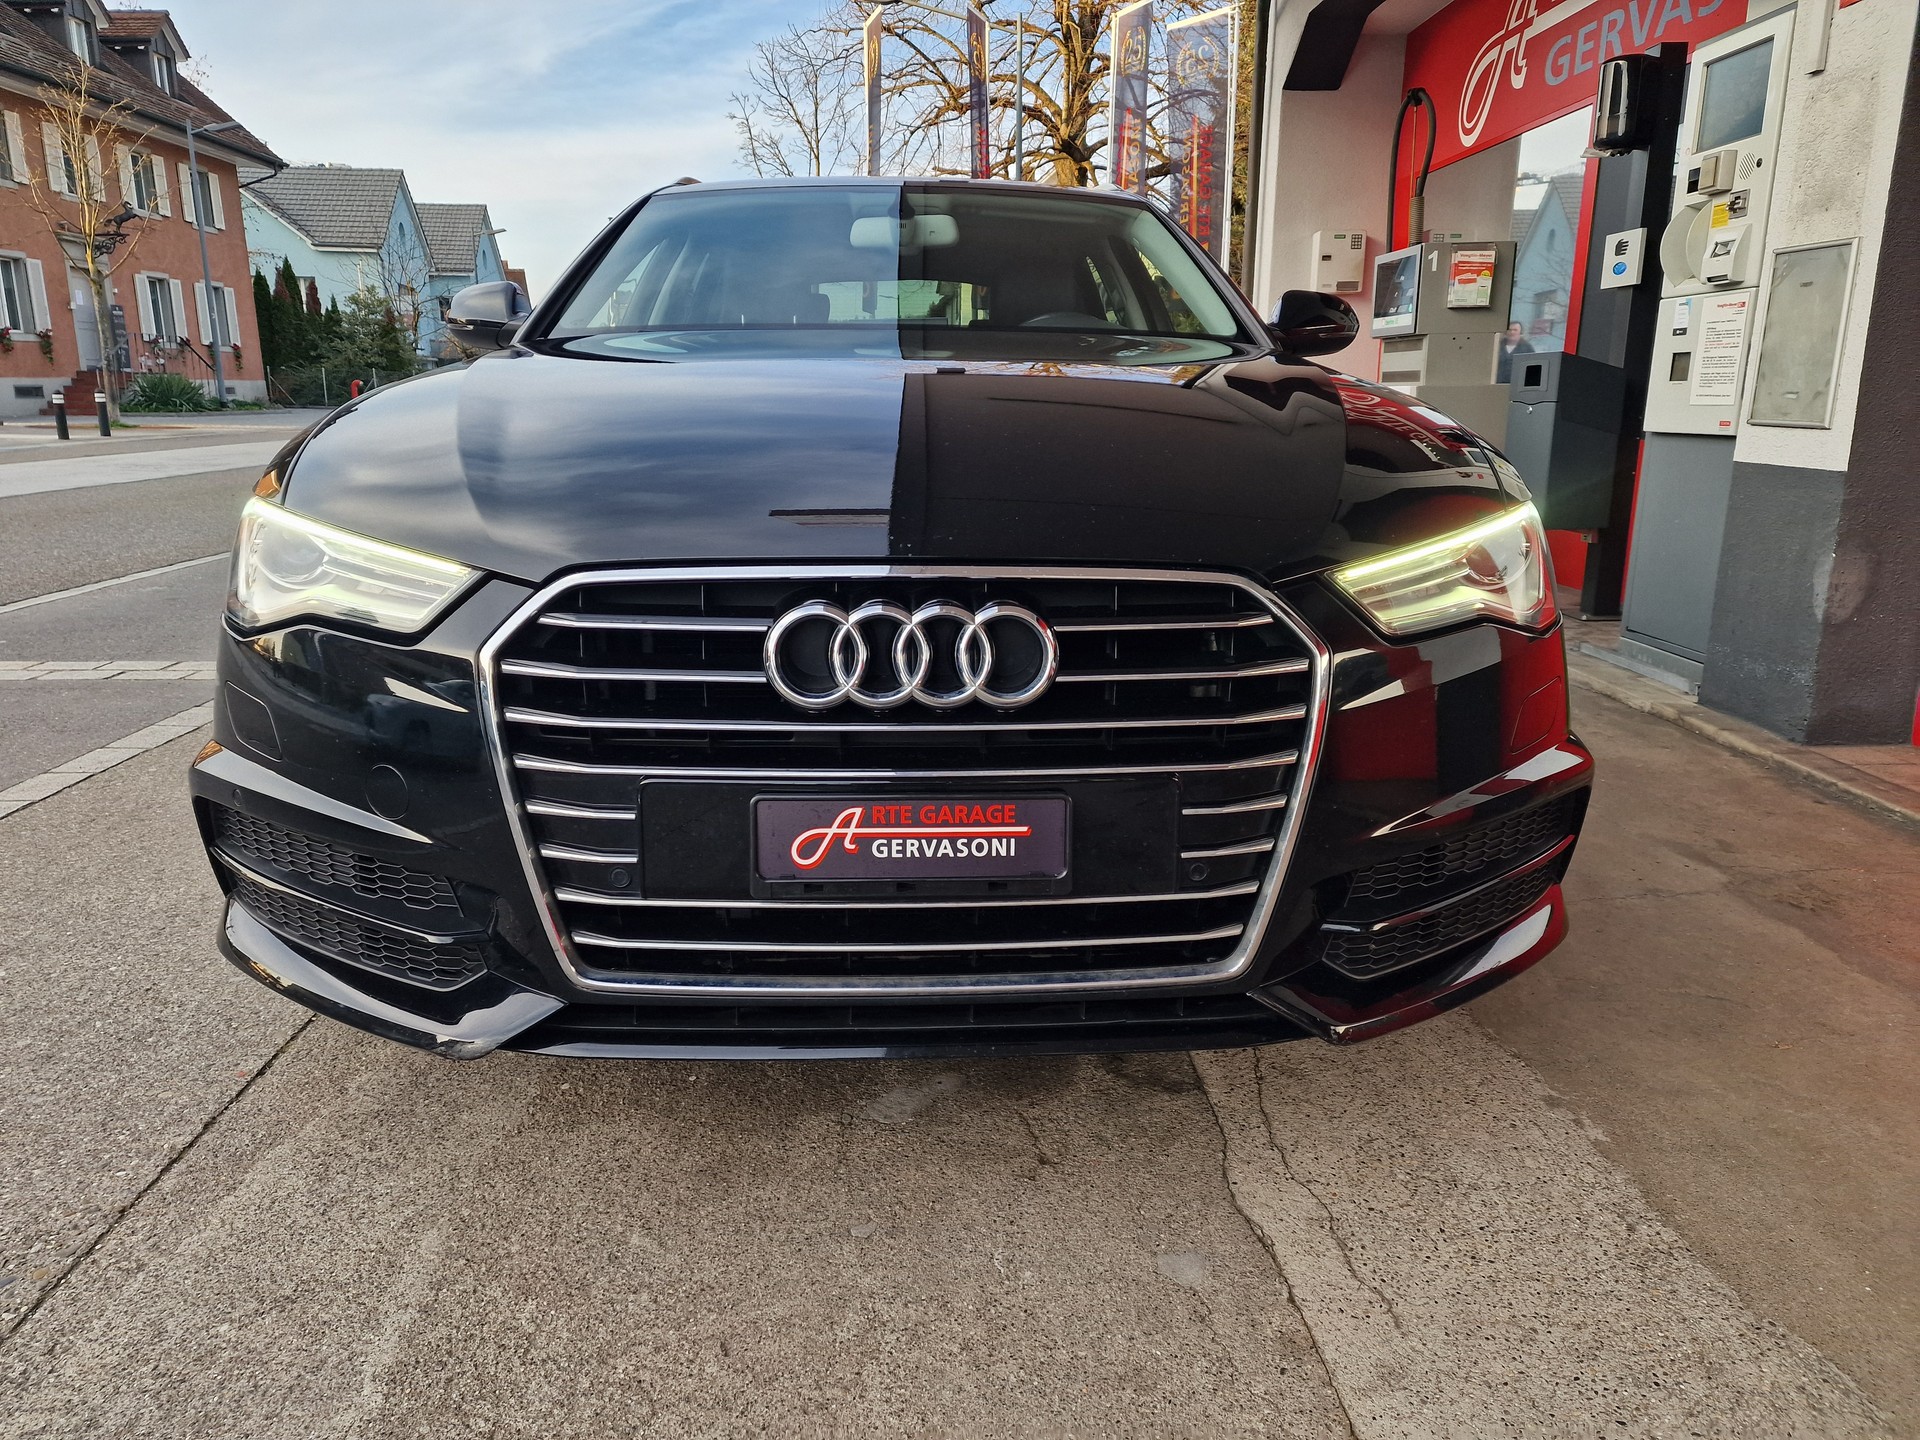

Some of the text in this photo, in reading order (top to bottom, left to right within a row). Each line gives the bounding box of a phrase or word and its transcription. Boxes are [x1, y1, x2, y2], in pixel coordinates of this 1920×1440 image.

[1428, 250, 1438, 271] 1
[919, 805, 1016, 824] GARAGE
[871, 838, 1016, 858] GERVASONI
